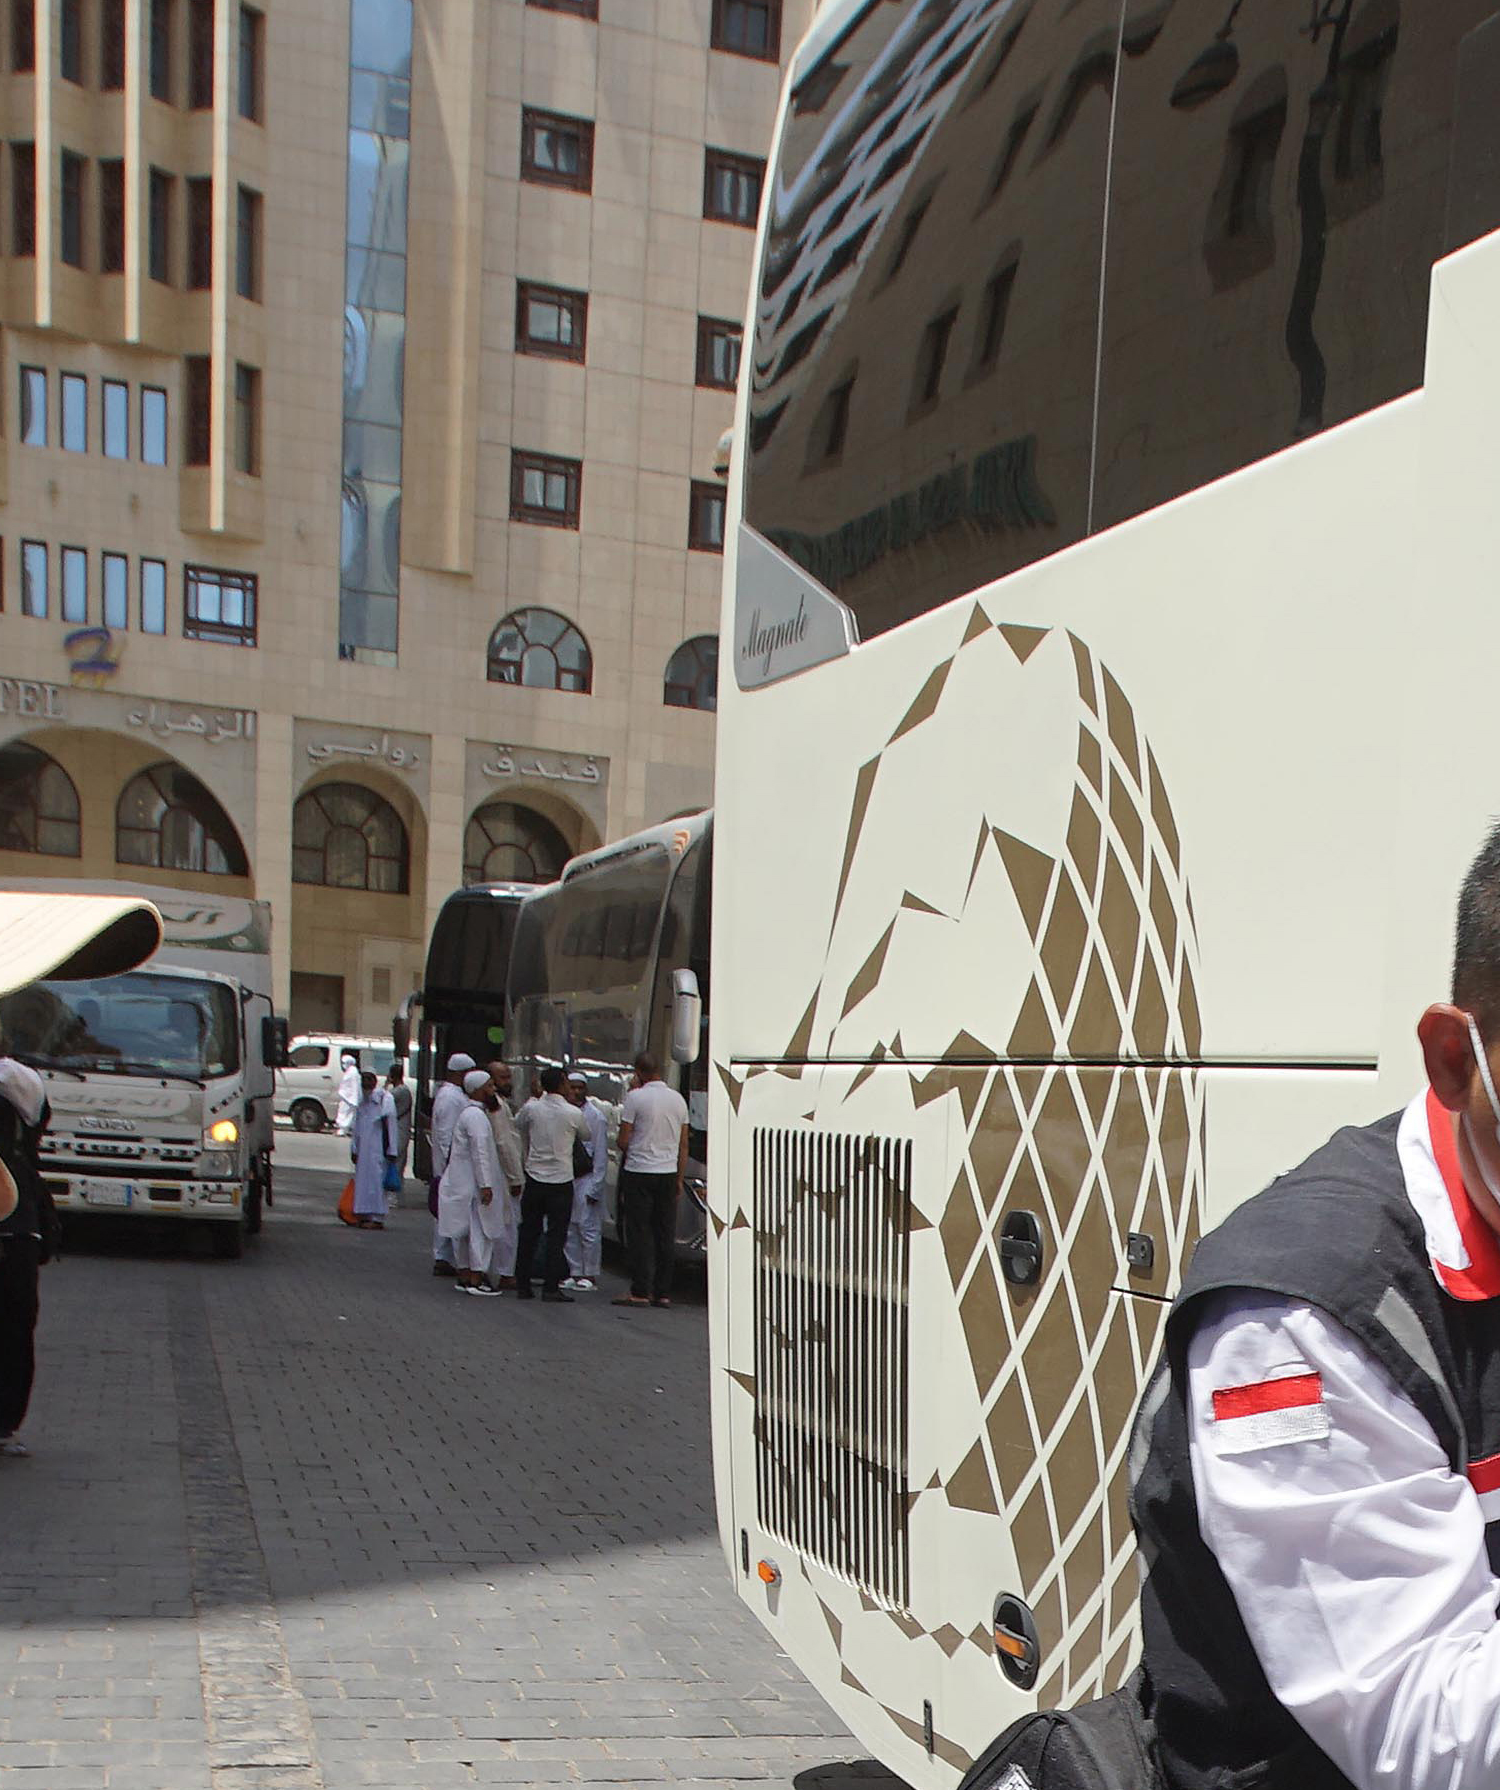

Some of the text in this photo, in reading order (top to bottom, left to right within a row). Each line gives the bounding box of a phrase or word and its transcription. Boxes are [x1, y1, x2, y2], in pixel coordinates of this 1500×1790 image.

[126, 703, 600, 784] فندق روابي الزهراء
